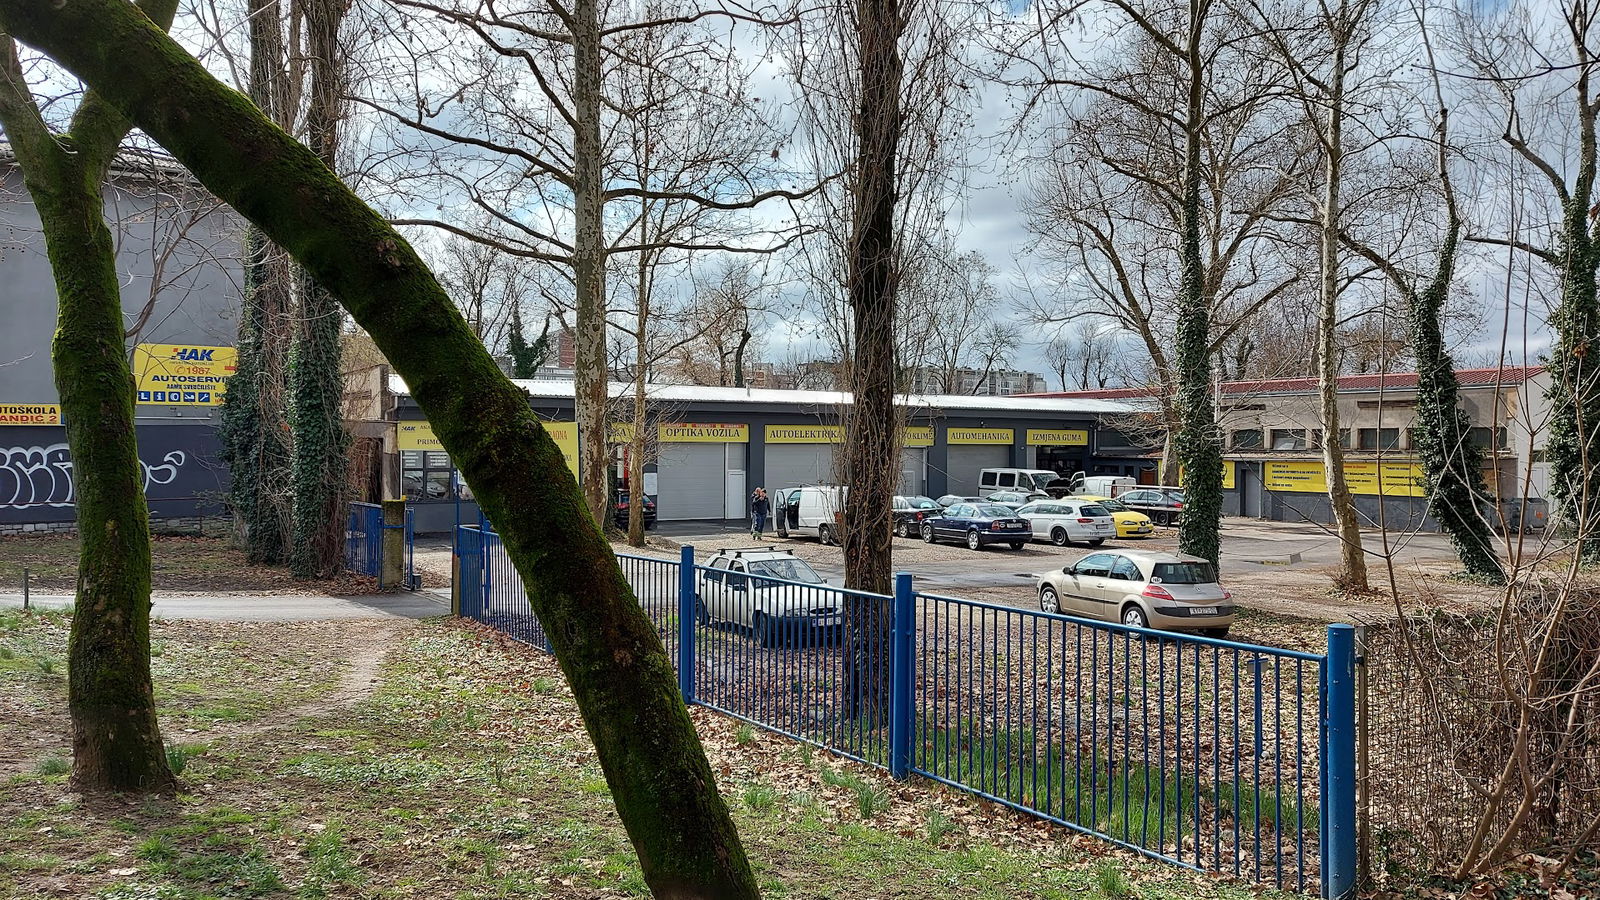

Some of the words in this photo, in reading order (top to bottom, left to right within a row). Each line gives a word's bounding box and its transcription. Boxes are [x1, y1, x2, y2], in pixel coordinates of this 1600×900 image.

[172, 347, 215, 361] HAK
[151, 375, 228, 384] AUTOSERVI
[665, 427, 704, 437] OPTIKA
[706, 428, 741, 438] VOZILA
[950, 432, 1010, 441] AUTOMEHANIKA
[1032, 433, 1061, 442] IZMJENA
